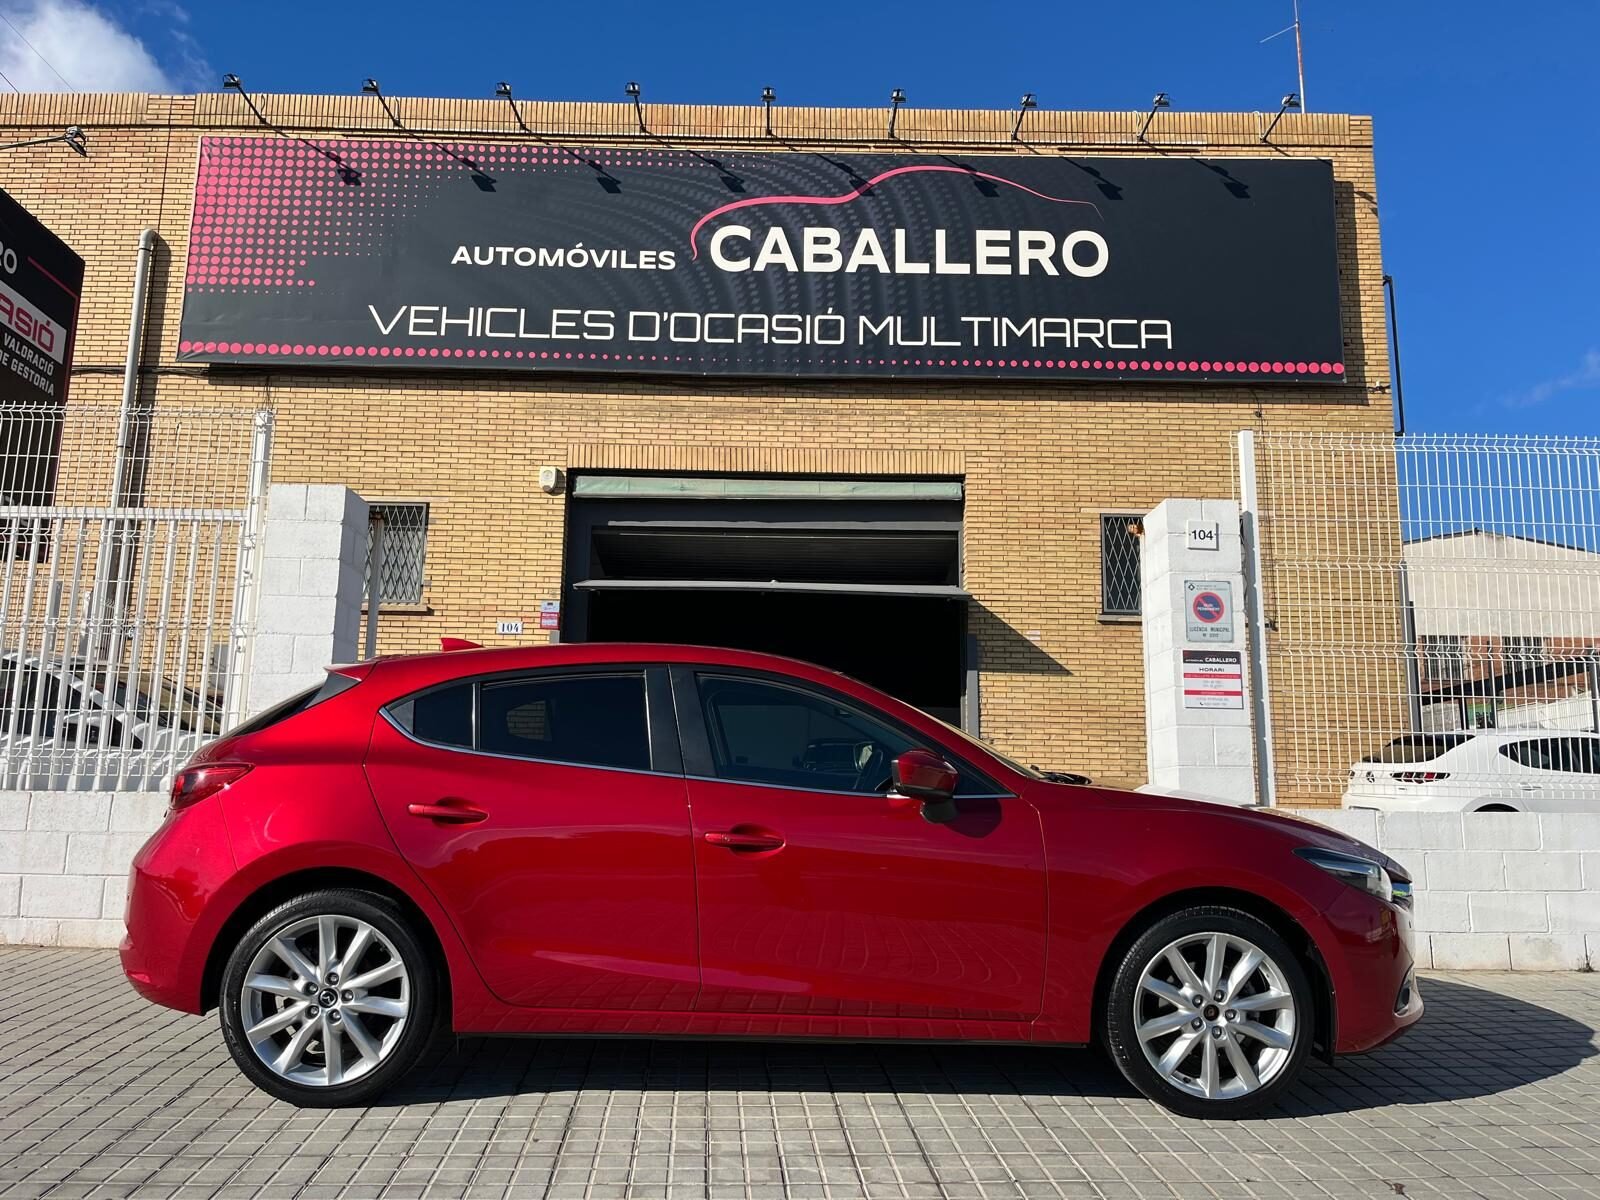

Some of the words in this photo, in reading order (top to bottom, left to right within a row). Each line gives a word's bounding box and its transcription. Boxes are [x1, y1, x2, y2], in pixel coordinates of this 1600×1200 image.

[0, 240, 17, 274] O
[451, 242, 677, 272] AUTOMÓVILES
[709, 225, 1109, 277] CABALLERO
[368, 304, 615, 341] VEHICLES
[628, 307, 845, 346] D'OCASIÓ
[858, 314, 1173, 350] MULTIMARCA
[4, 332, 54, 376] VALORACIÓ
[11, 358, 54, 396] GESTORIA
[1191, 529, 1214, 541] 104
[501, 623, 519, 633] 104
